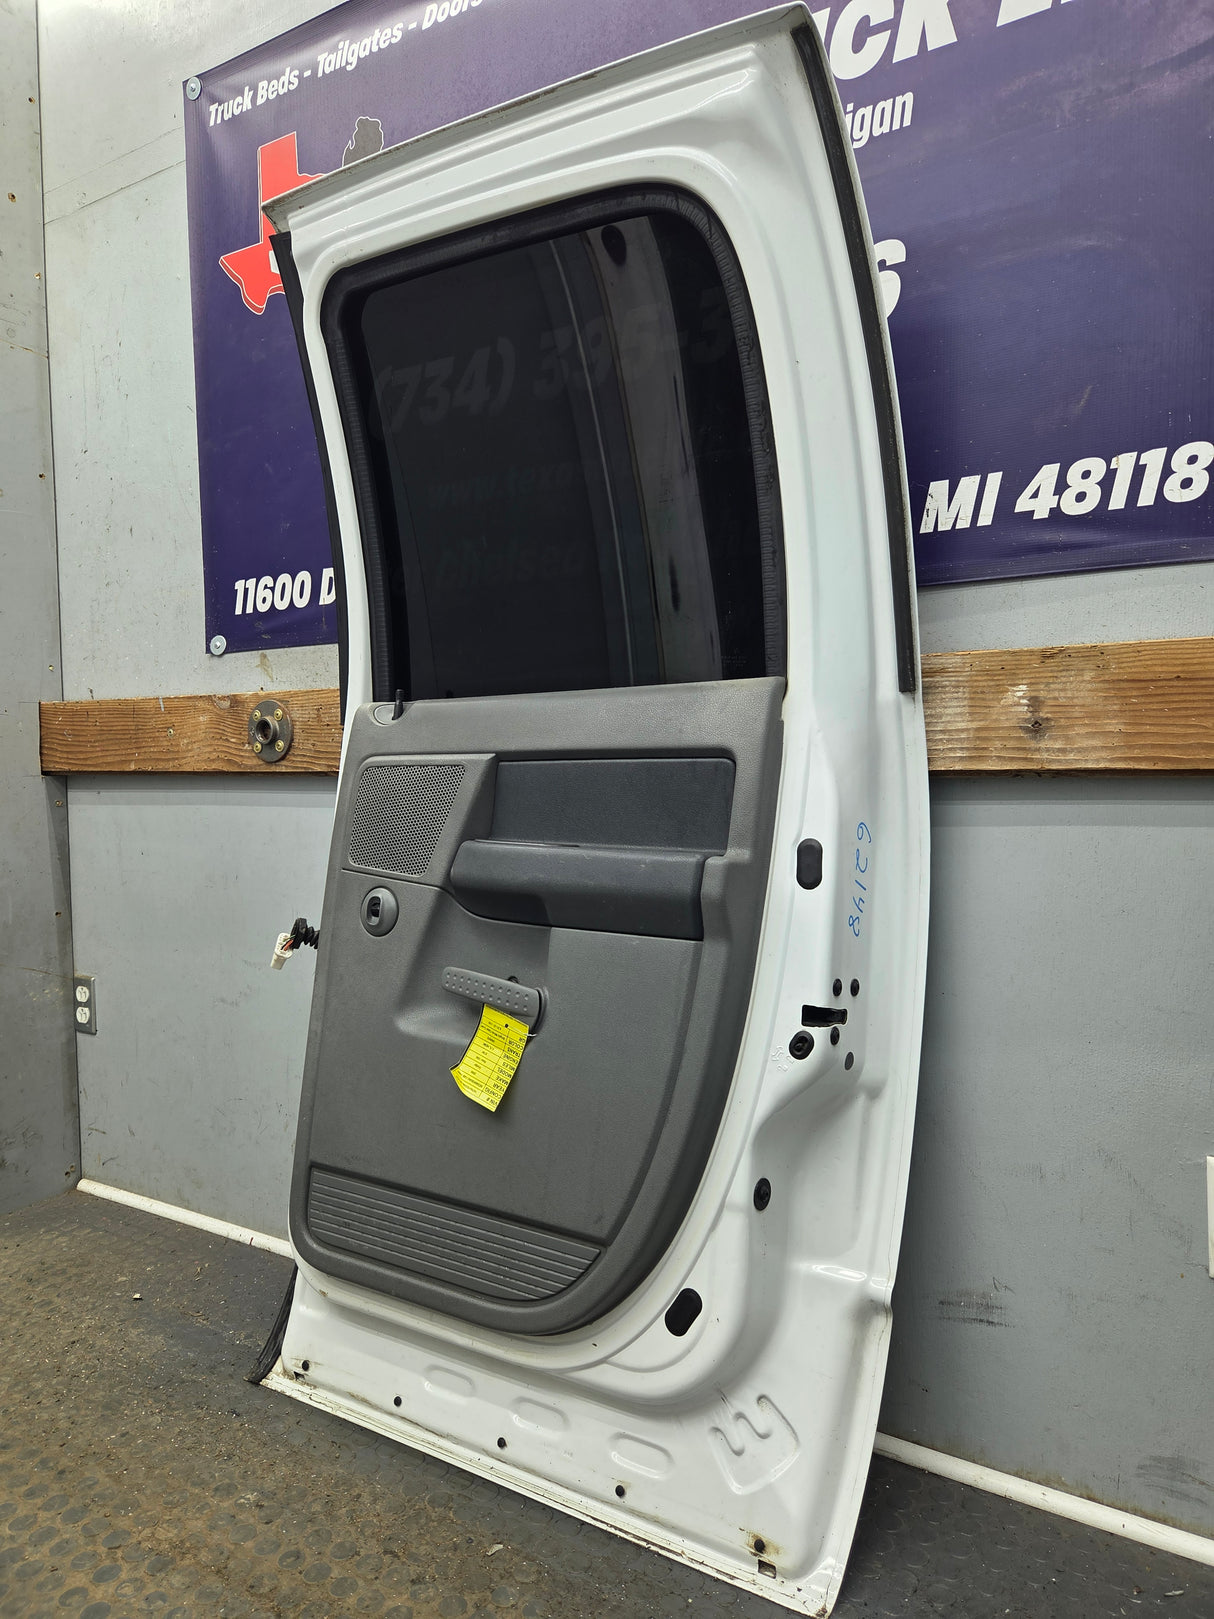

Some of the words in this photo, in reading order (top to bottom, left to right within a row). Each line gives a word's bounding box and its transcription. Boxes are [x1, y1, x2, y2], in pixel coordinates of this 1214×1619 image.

[209, 86, 254, 127] Truck
[257, 67, 299, 106] Beds
[303, 69, 312, 78] -
[316, 21, 404, 78] Tailgates
[408, 21, 418, 31] -
[919, 471, 1003, 534] MI
[1014, 441, 1214, 520] 48118
[234, 570, 312, 615] 11600
[508, 1040, 524, 1051] COLOR
[507, 1047, 520, 1058] TRANS
[502, 1053, 519, 1065] ENGINE
[502, 1061, 516, 1071] MILES
[497, 1067, 512, 1078] MODEL
[496, 1075, 509, 1086] MAKE
[492, 1082, 505, 1092] YEAR
[485, 1087, 502, 1099] CONFIG
